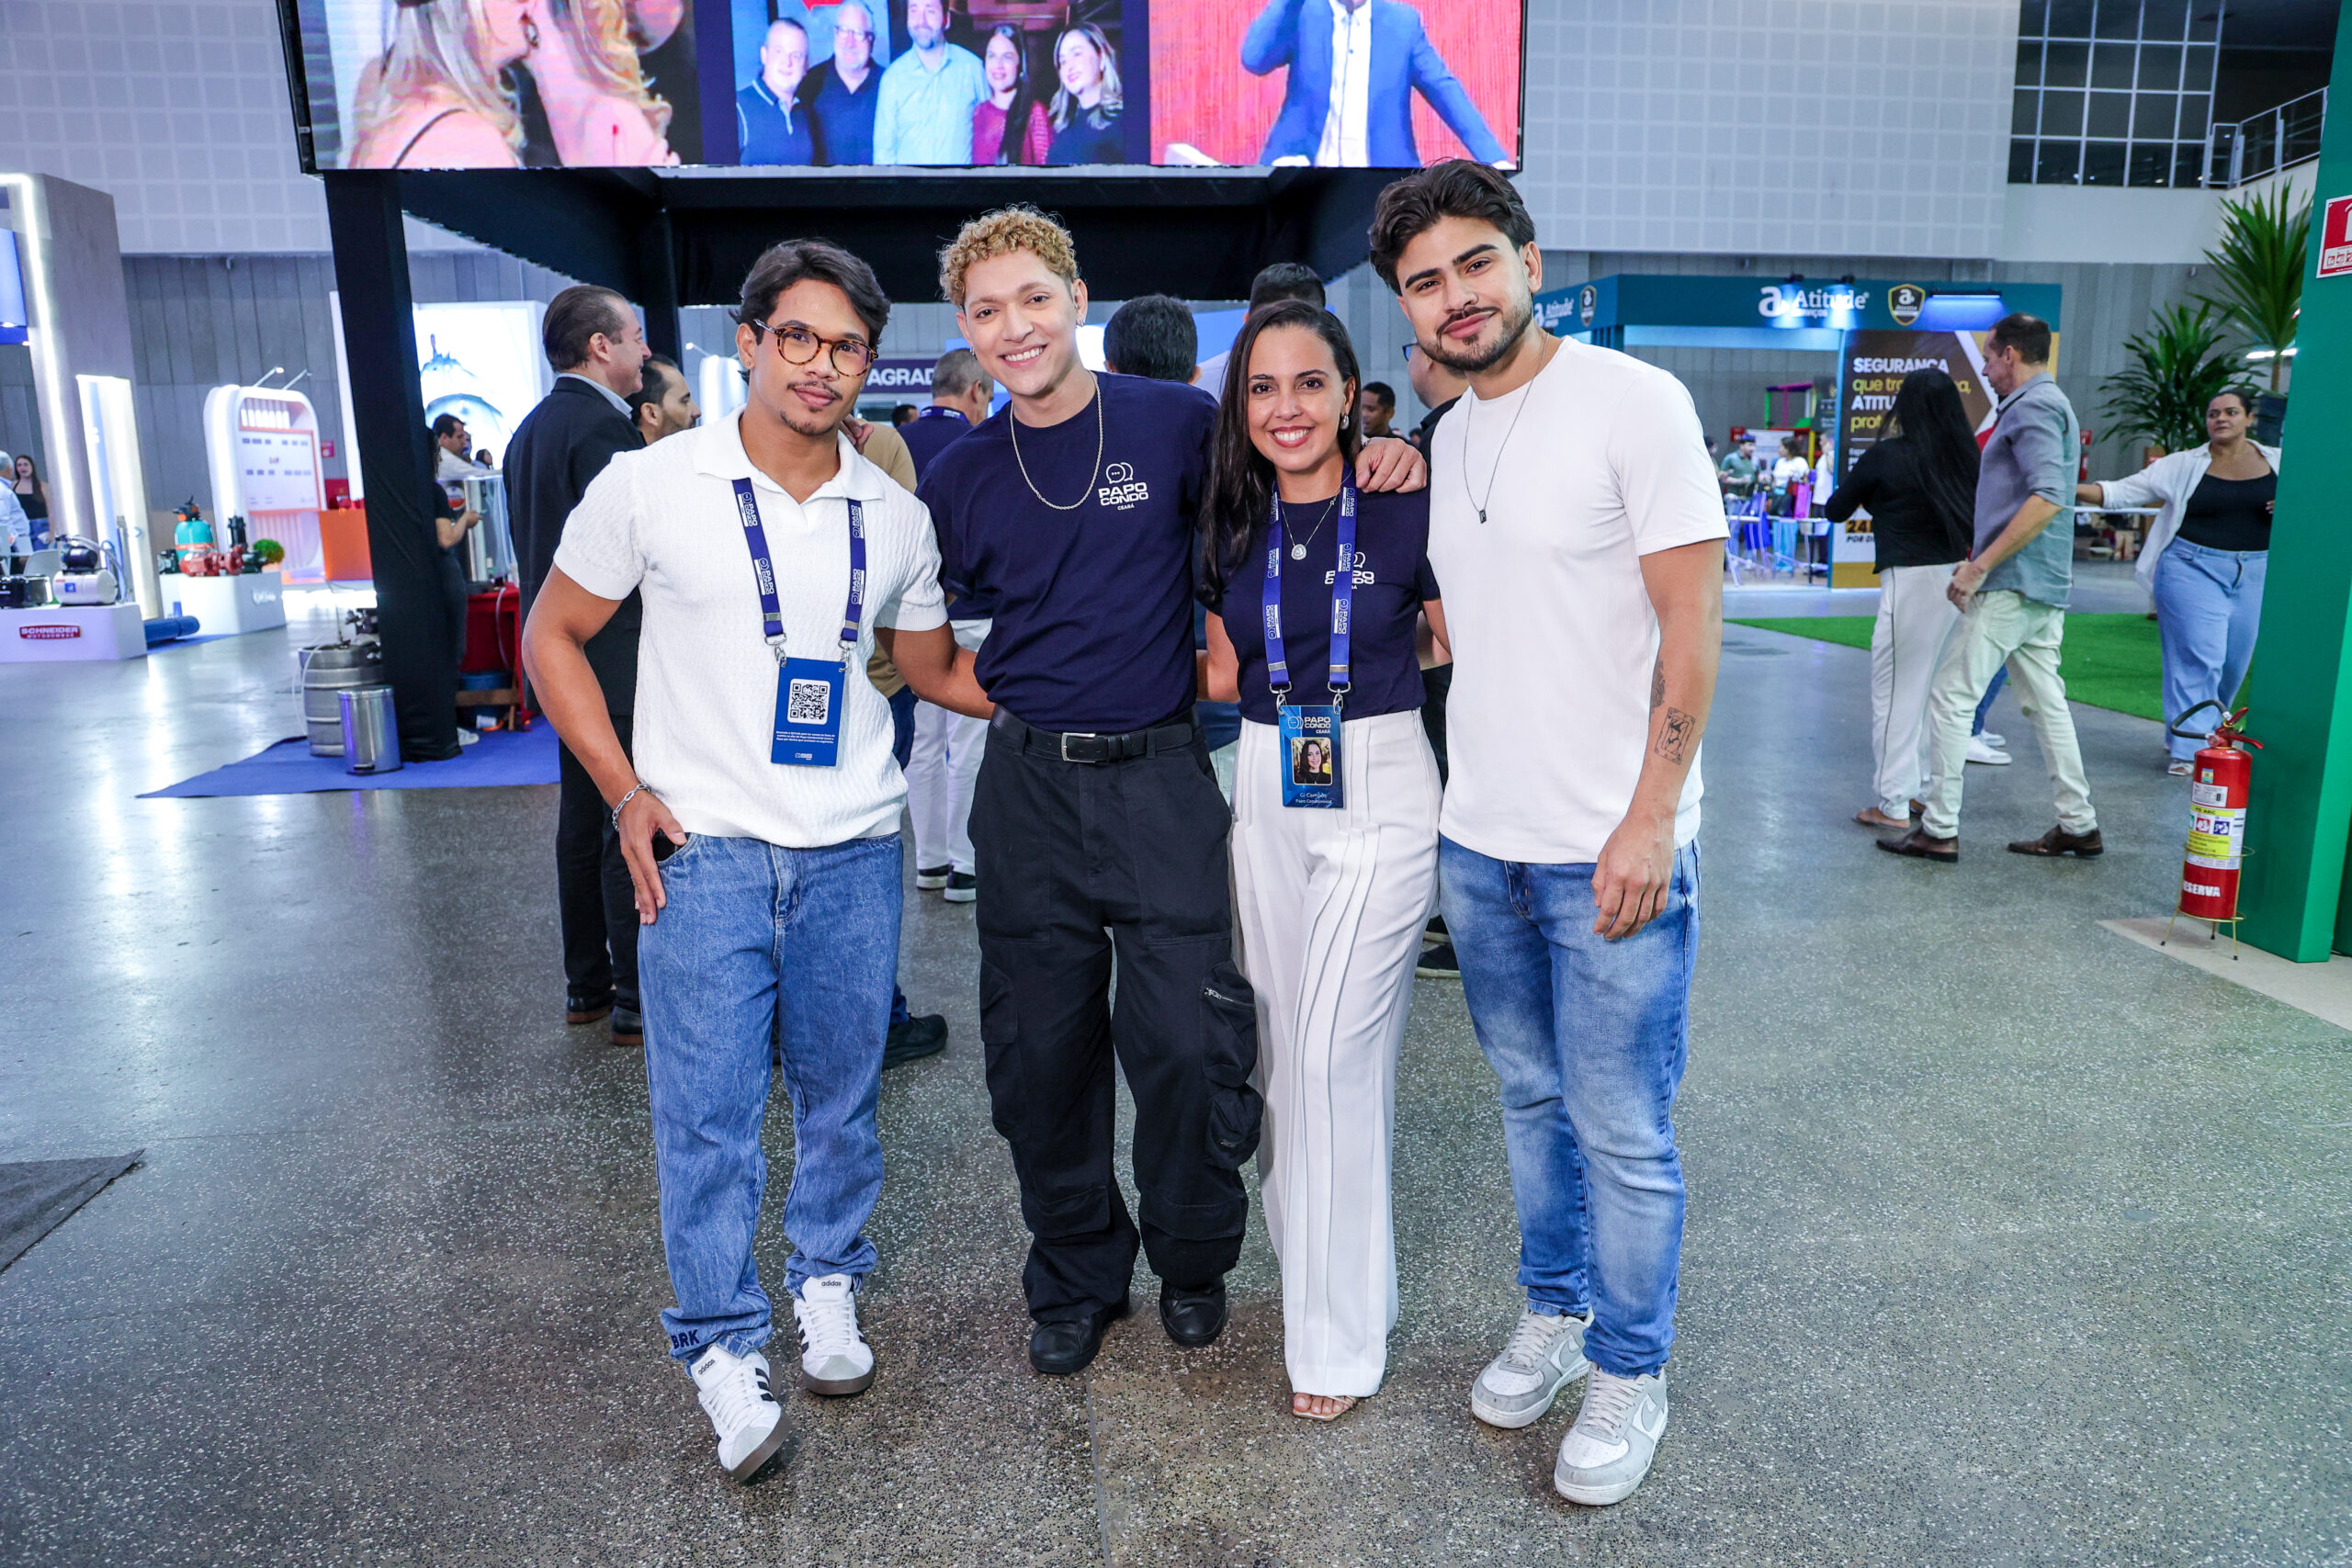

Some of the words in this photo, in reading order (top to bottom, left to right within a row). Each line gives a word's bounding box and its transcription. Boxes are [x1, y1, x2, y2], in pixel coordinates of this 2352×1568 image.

[1852, 378, 1884, 395] que
[1098, 482, 1148, 499] PAPO
[1101, 491, 1148, 506] CONDO
[749, 503, 758, 526] PAPO
[1117, 502, 1135, 511] CEARÁ
[766, 570, 775, 594] PAPO
[1326, 570, 1374, 580] PPO
[21, 626, 78, 635] SCHNEIDER
[671, 1329, 699, 1349] BRK
[698, 1359, 716, 1374] adidas
